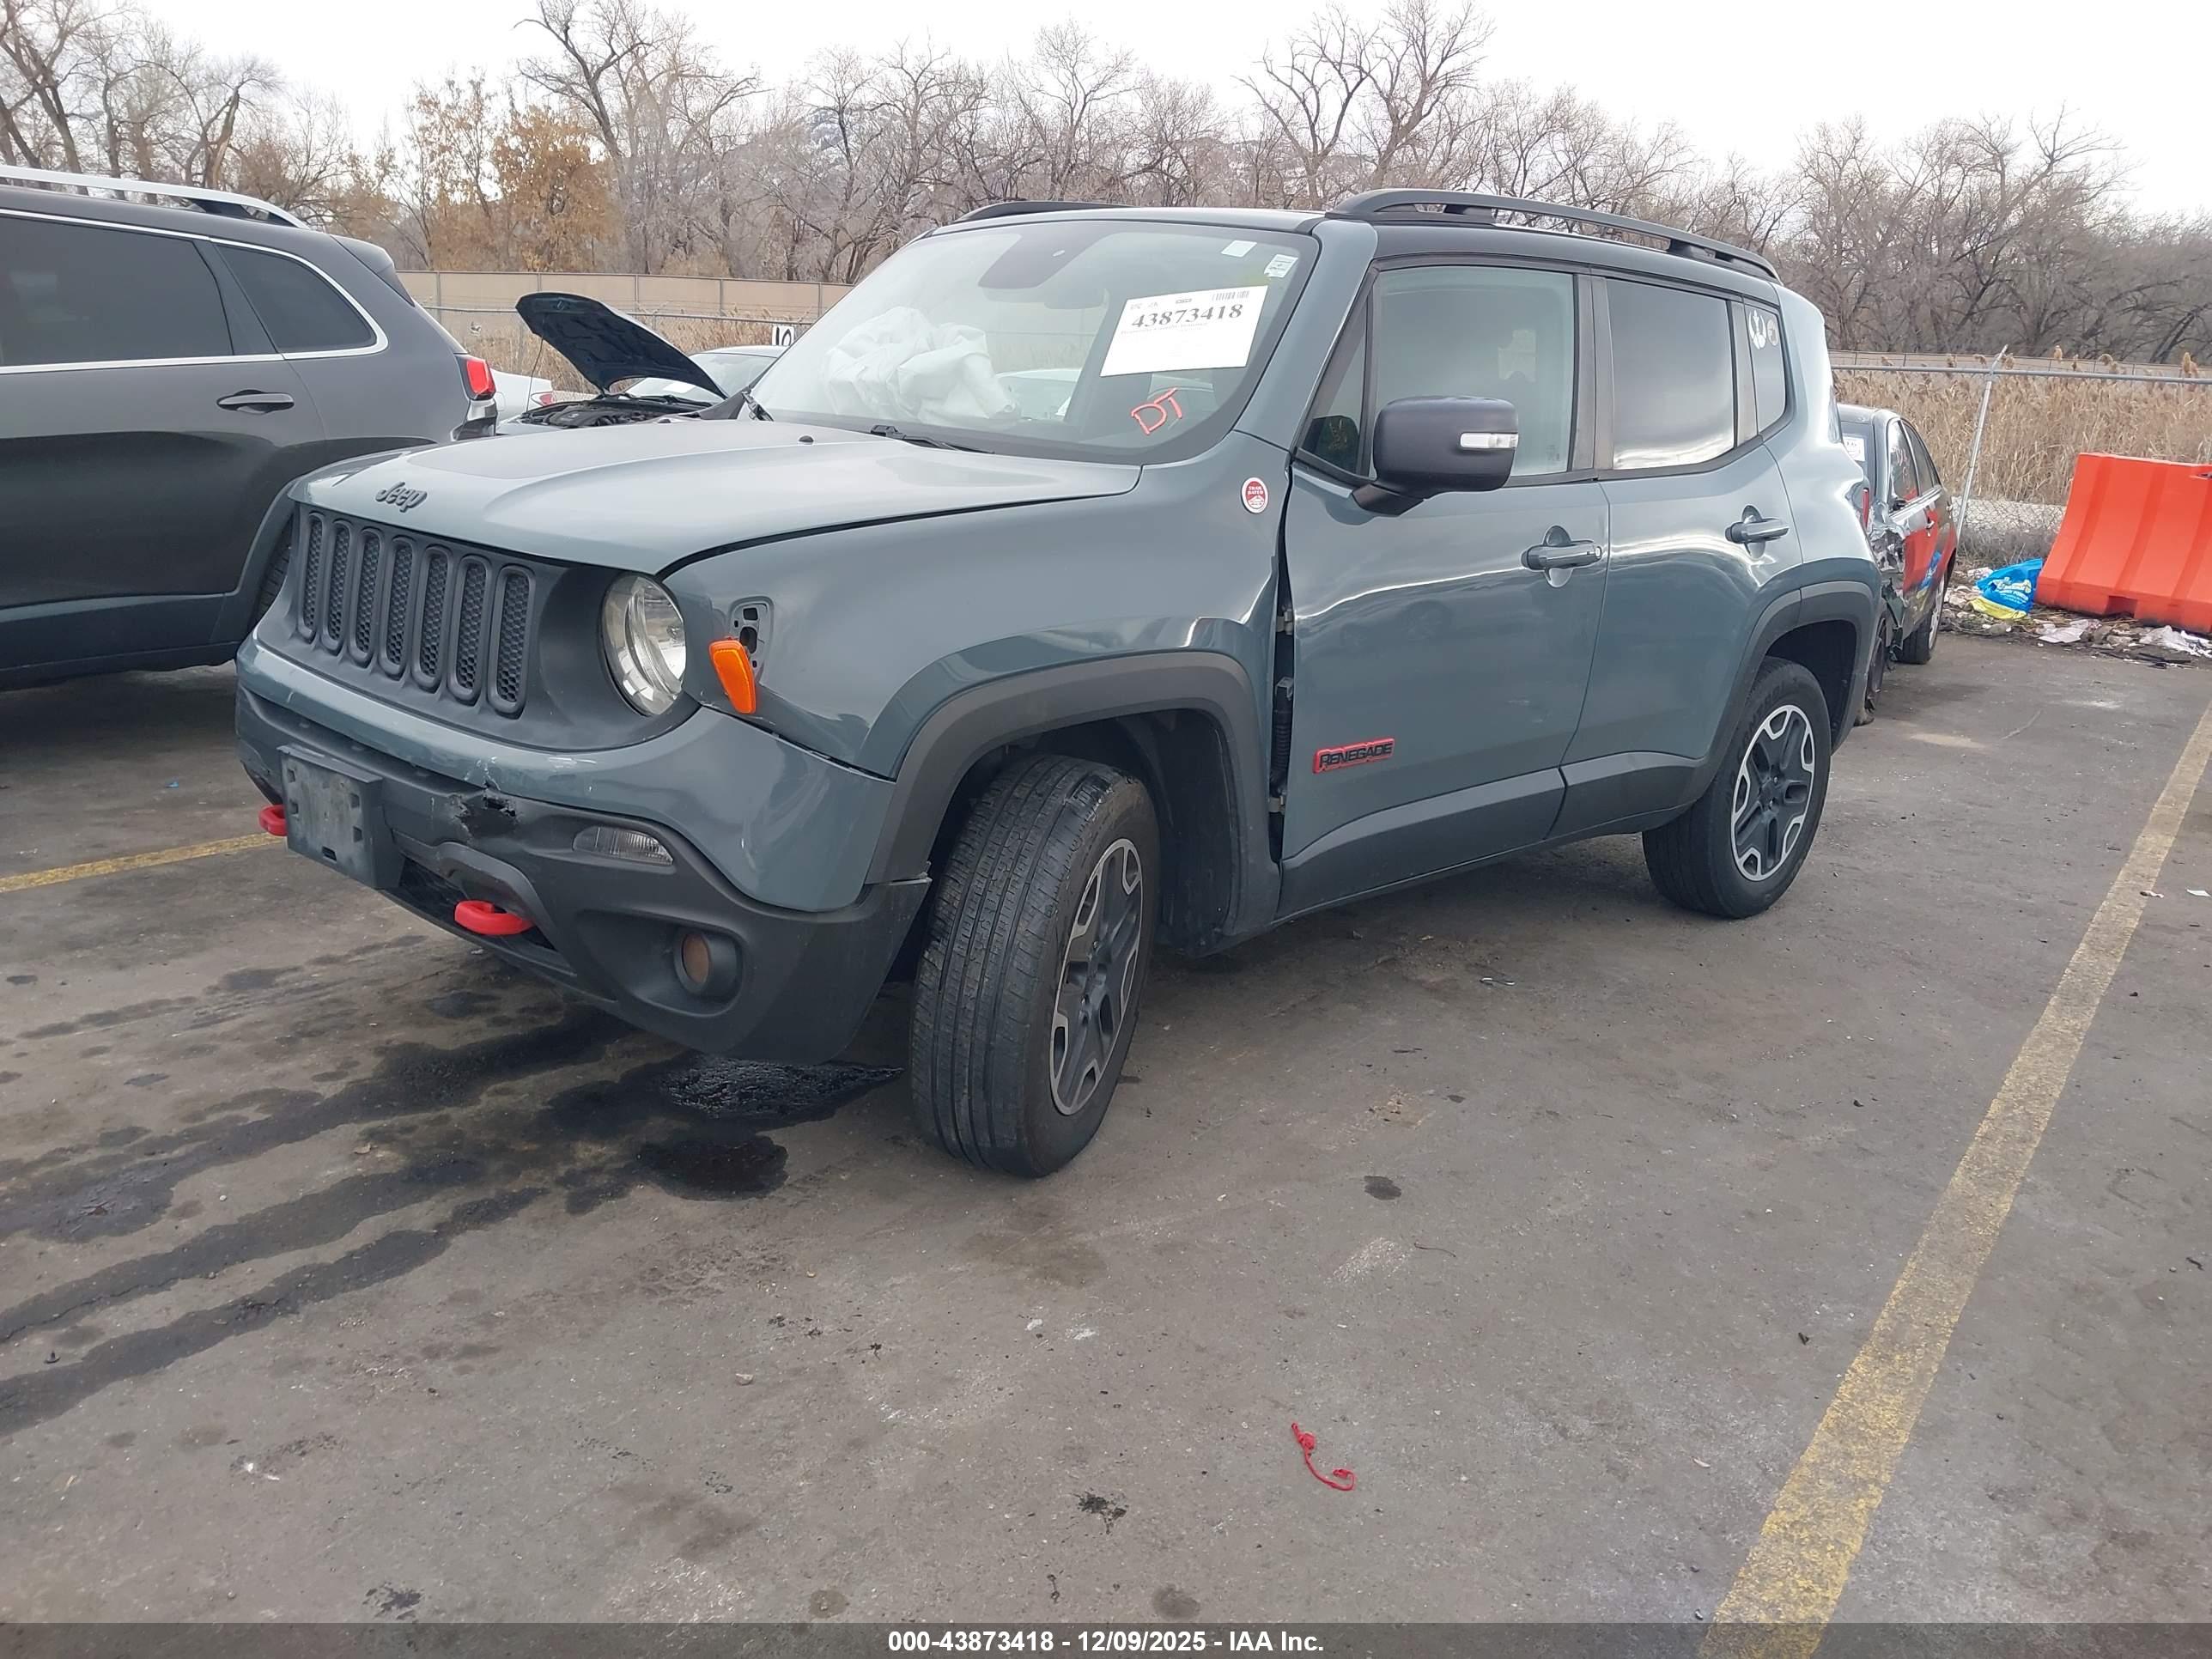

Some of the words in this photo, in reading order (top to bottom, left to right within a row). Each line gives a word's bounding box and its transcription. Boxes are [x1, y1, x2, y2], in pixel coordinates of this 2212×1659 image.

[1131, 303, 1243, 328] 43873418
[375, 481, 428, 514] Jeep
[1317, 741, 1394, 769] RENEGADE
